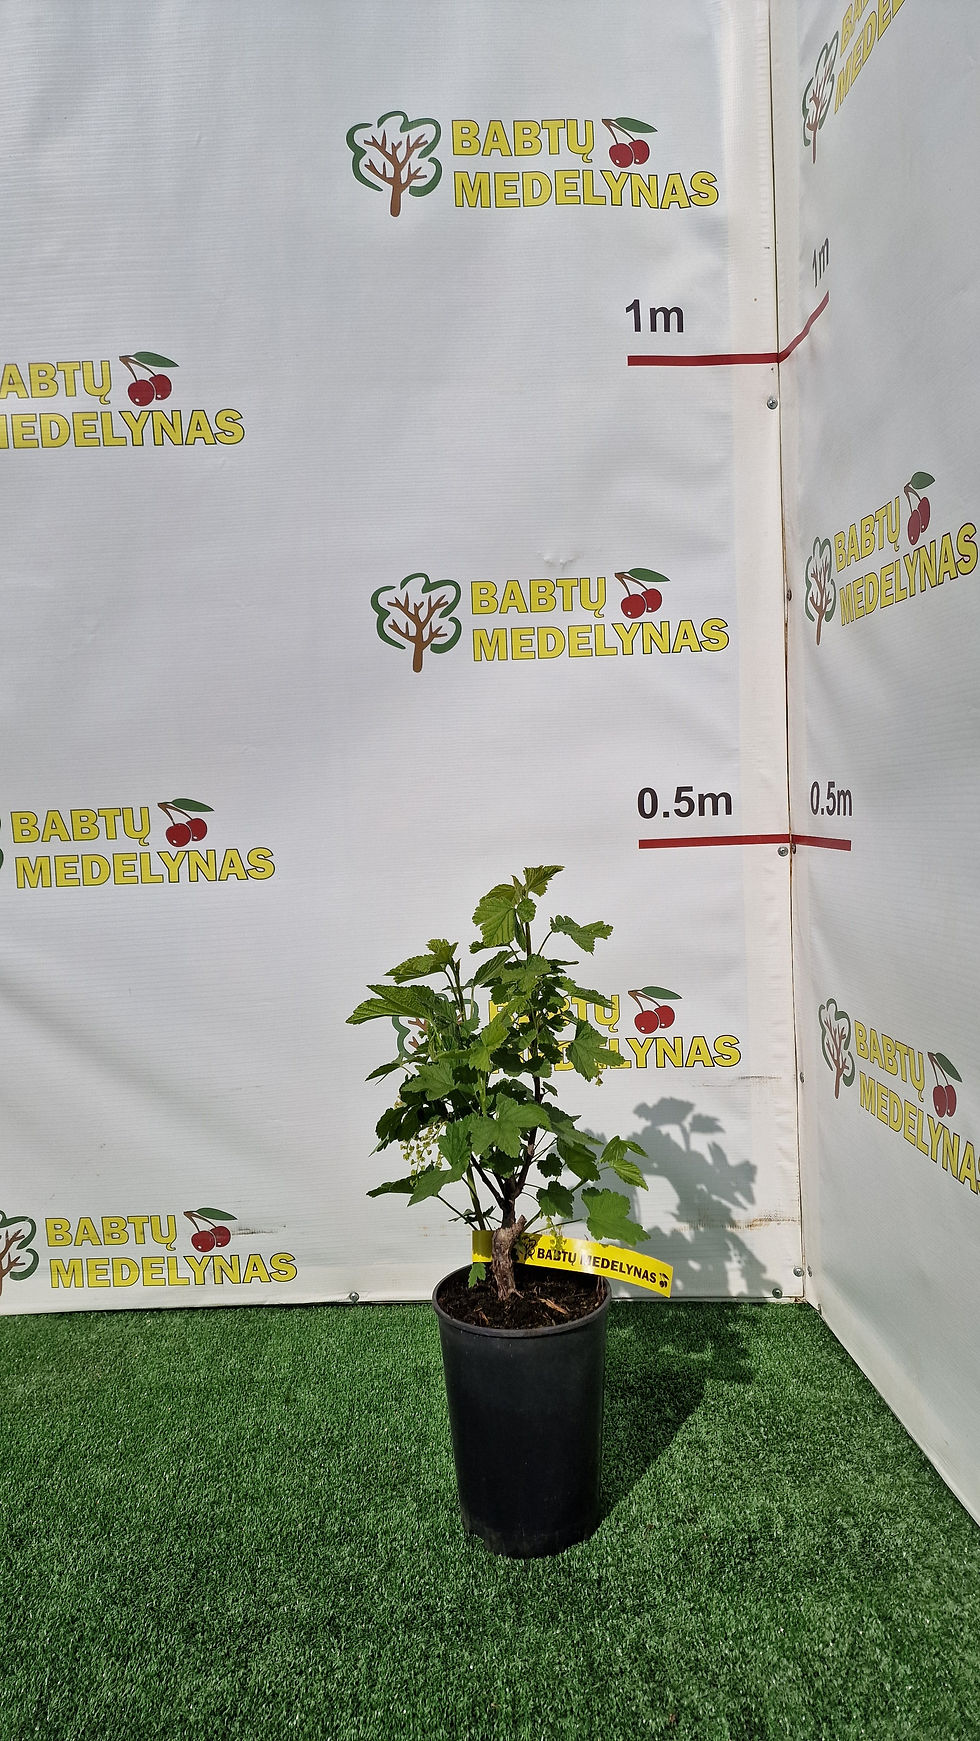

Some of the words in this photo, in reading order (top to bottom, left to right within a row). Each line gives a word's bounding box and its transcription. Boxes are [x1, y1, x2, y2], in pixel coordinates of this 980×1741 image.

[451, 119, 595, 163] BABTŲ
[453, 170, 719, 210] MEDELYNAS
[811, 238, 829, 288] 1m
[625, 298, 684, 333] 1m
[0, 409, 245, 449] EDELYNAS
[833, 496, 901, 573] BABTŲ
[839, 523, 979, 626] MEDELYNAS
[471, 577, 606, 619] BABTŲ
[472, 618, 730, 662] MEDELYNAS
[637, 785, 733, 820] 0.5m
[810, 781, 853, 817] 0.5m
[10, 806, 151, 846] BABTŲ
[15, 846, 276, 889] MEDELYNAS
[854, 1020, 925, 1103] BABTŲ
[860, 1071, 980, 1195] MEDELYNA
[45, 1215, 178, 1252] BABTŲ
[50, 1252, 298, 1289] MEDELYNAS
